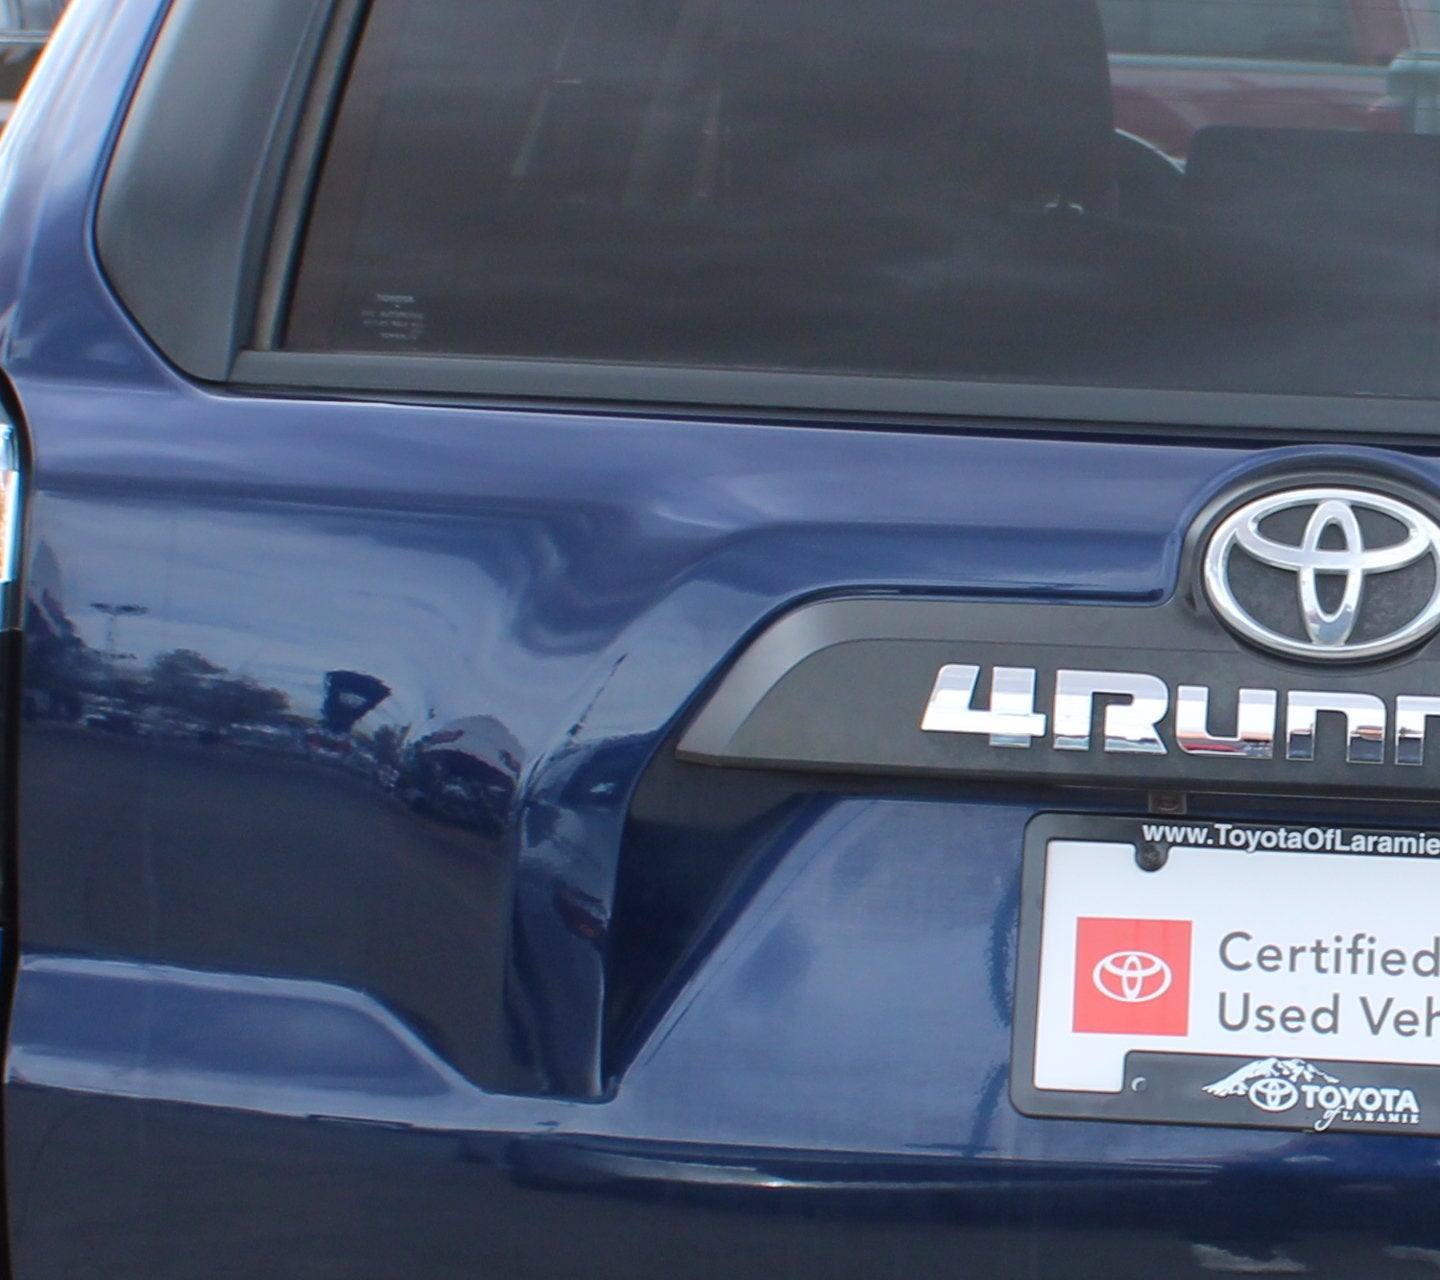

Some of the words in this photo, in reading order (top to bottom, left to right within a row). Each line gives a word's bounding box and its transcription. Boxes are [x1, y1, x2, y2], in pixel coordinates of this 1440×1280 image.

[1219, 931, 1440, 977] Certified
[1218, 992, 1340, 1035] Used
[1301, 1084, 1419, 1113] TOYOTA
[1314, 1105, 1344, 1132] of
[1342, 1111, 1419, 1124] LARAMIE
